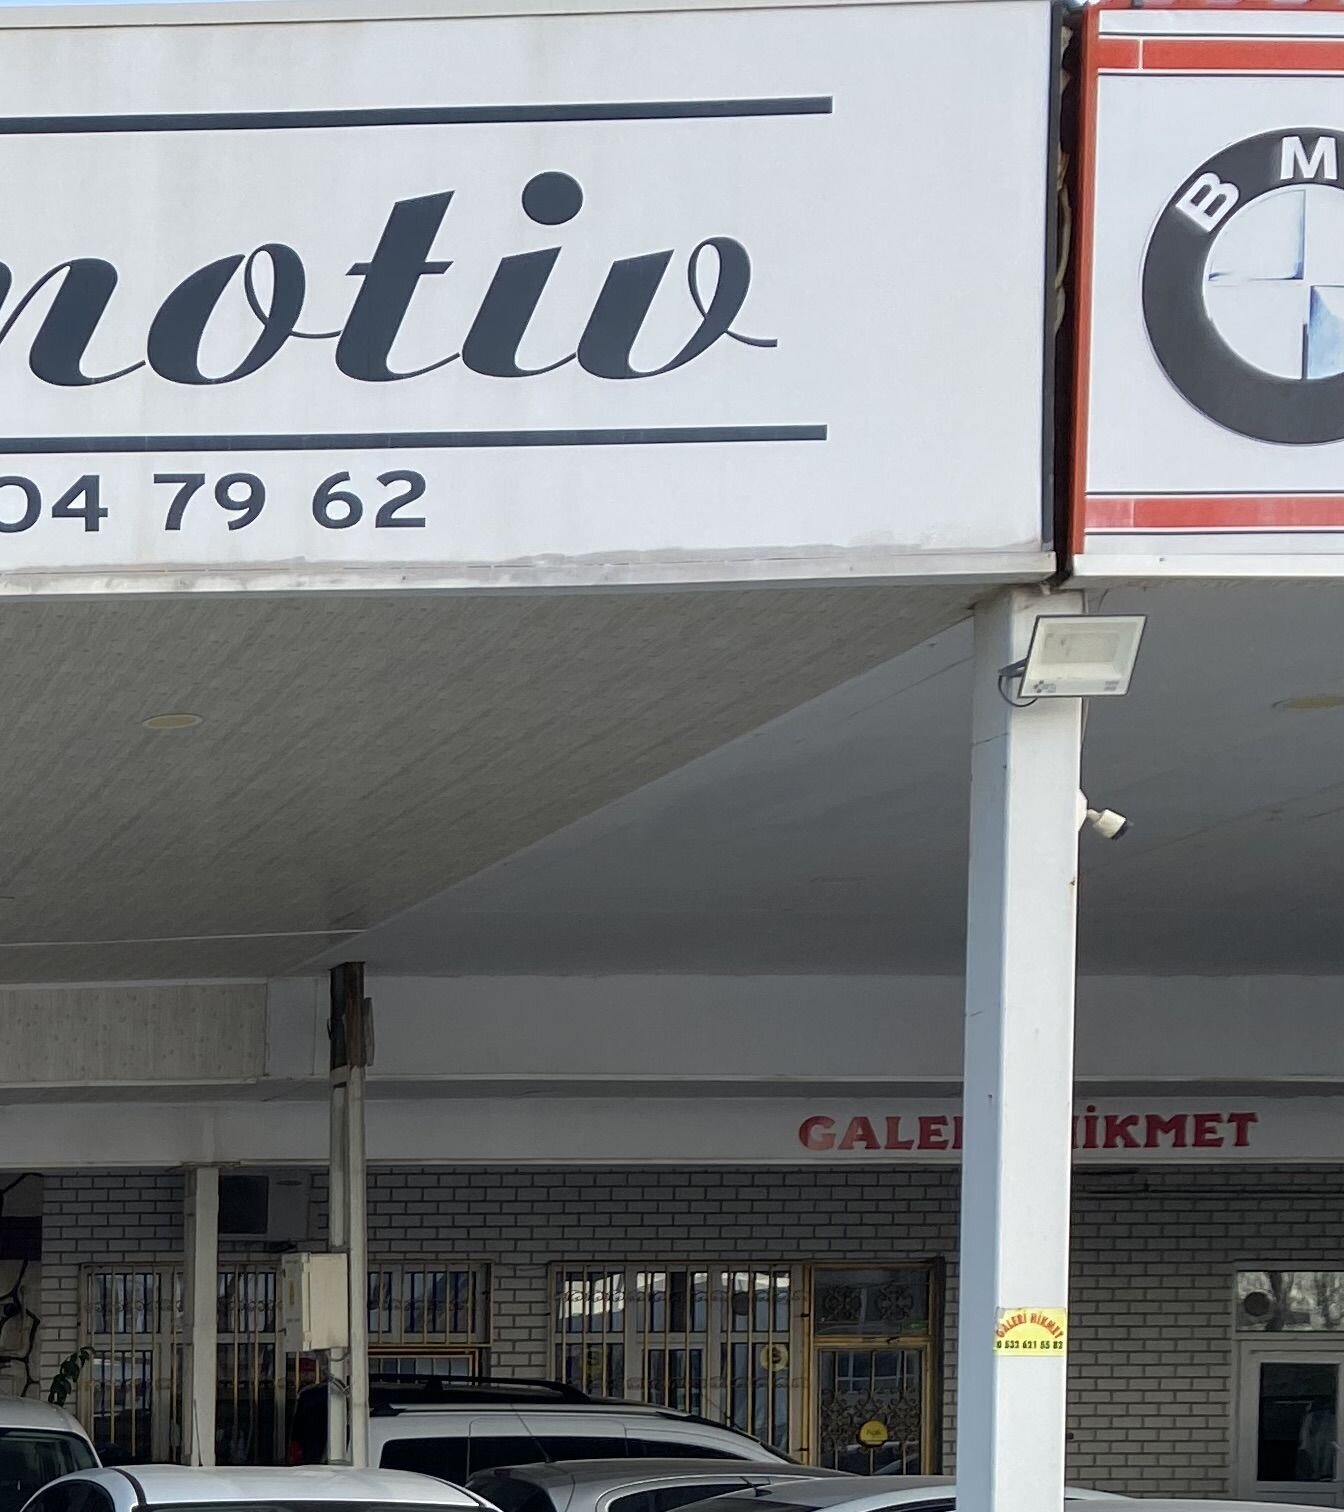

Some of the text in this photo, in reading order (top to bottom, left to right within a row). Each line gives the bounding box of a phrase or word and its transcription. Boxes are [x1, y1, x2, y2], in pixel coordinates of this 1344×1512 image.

[1175, 134, 1344, 232] BM
[153, 472, 266, 531] 79
[312, 470, 426, 530] 62
[798, 1103, 1259, 1151] GALE İKMET
[996, 1340, 1002, 1349] 0
